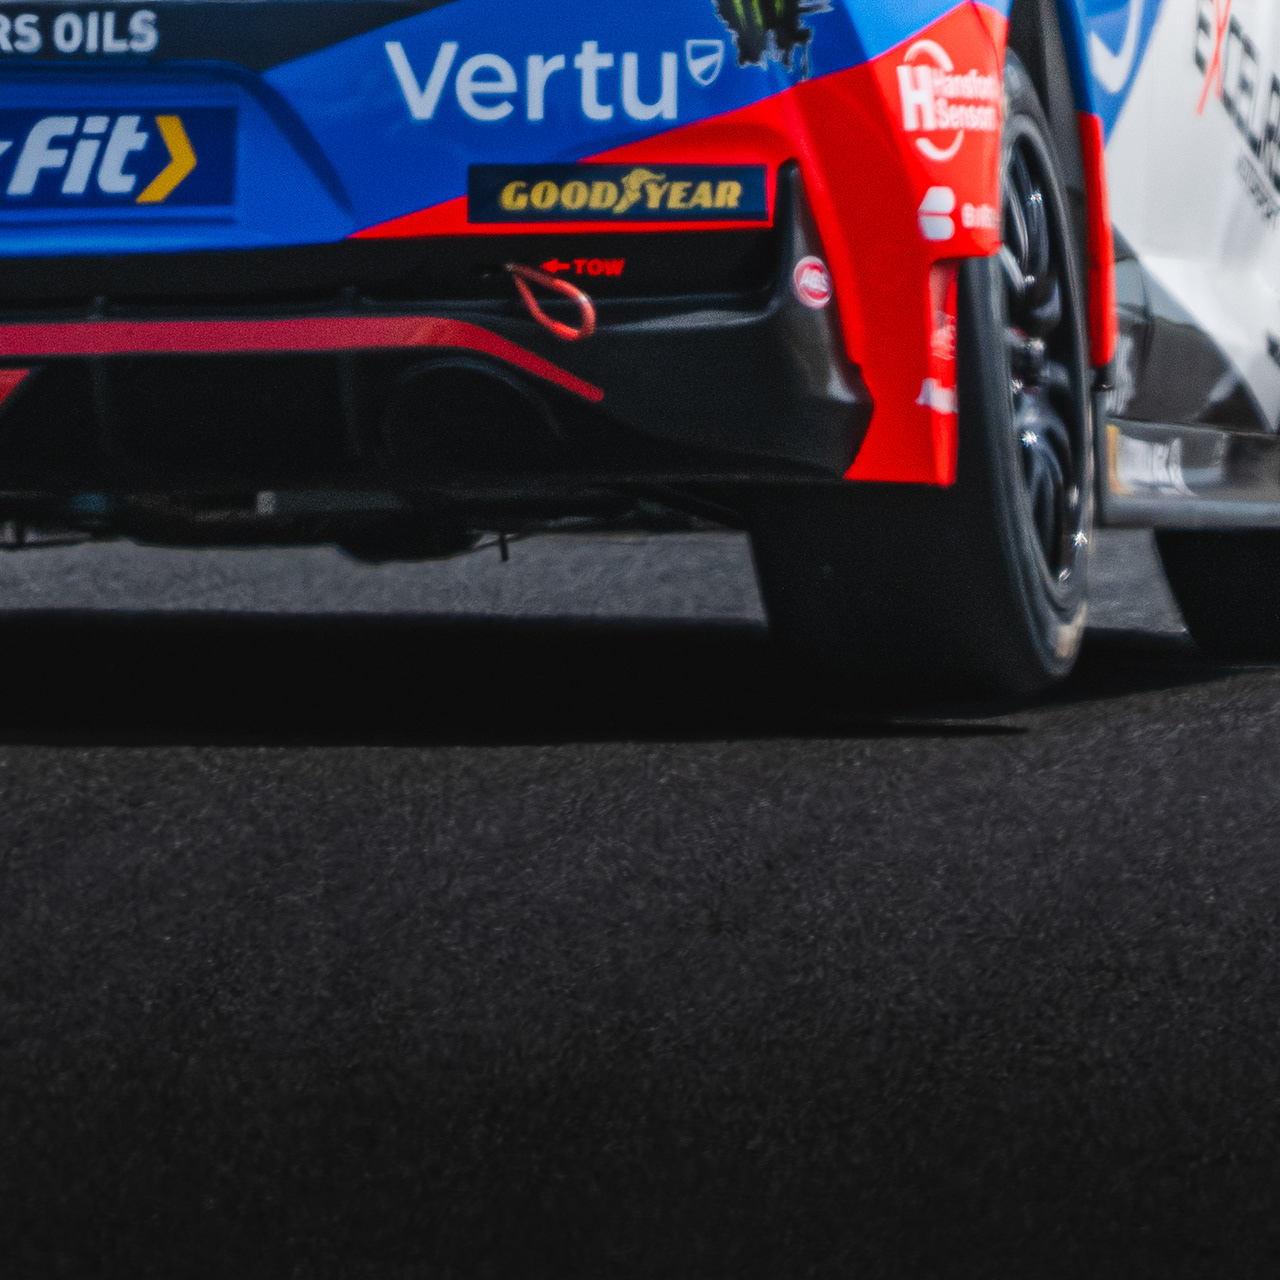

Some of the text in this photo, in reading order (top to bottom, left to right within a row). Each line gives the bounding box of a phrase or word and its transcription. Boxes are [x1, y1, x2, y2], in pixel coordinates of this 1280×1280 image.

[53, 10, 157, 53] OILS
[385, 41, 679, 121] Vertu
[573, 258, 625, 277] TOW
